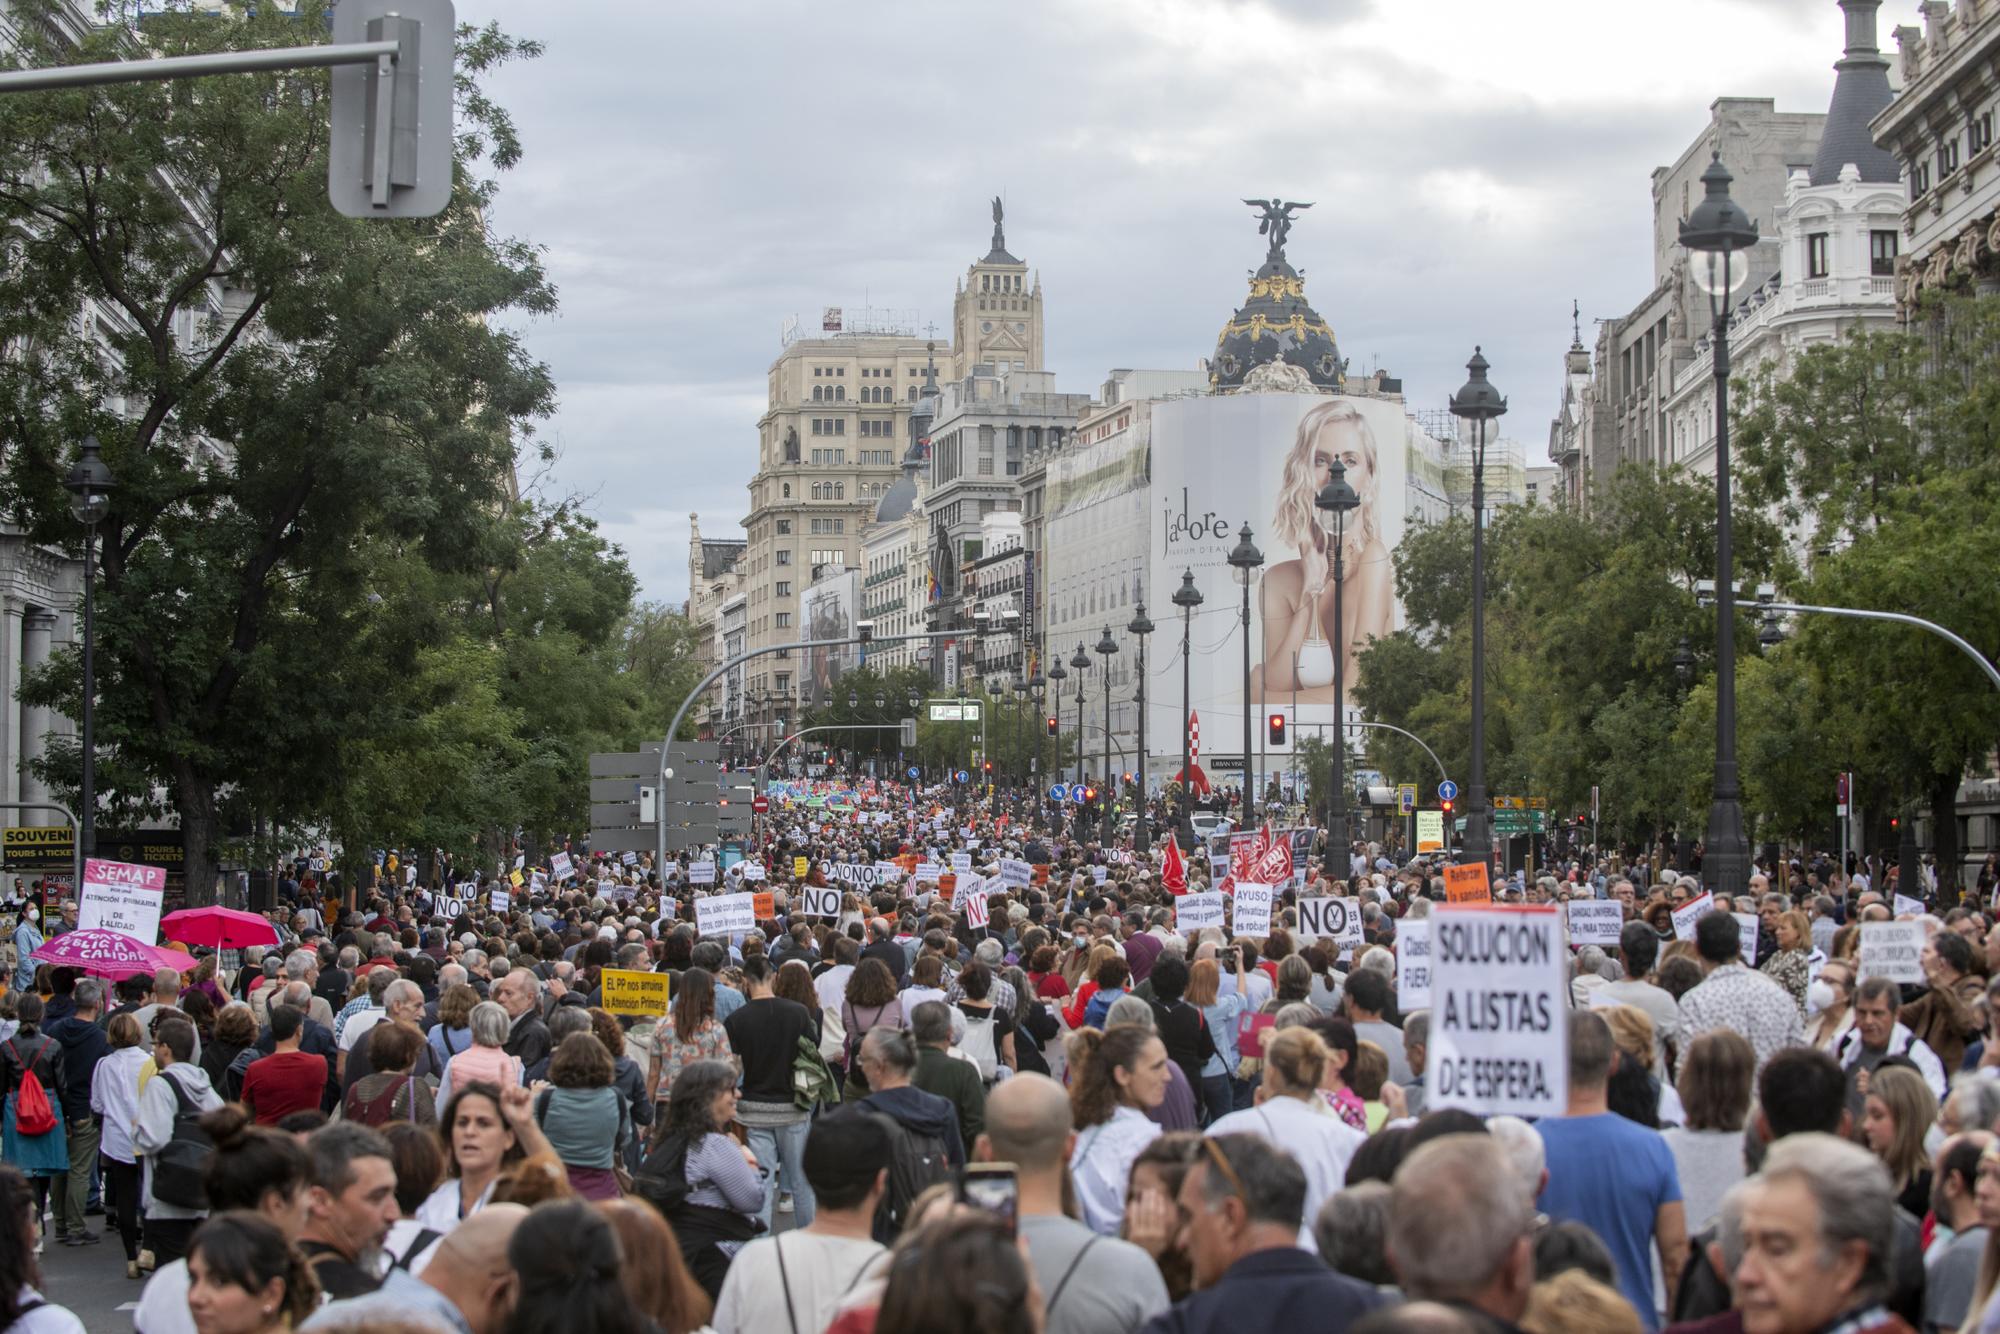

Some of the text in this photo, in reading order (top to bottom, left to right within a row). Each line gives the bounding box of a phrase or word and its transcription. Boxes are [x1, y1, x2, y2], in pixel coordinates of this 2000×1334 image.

[6, 830, 73, 842] SOUVENI
[144, 853, 184, 861] TICKETS
[96, 865, 156, 885] SEMAP
[836, 864, 851, 879] NO
[852, 866, 874, 882] NO
[436, 897, 461, 918] NO
[804, 889, 840, 914] NO
[113, 912, 124, 920] DE
[1299, 900, 1347, 934] NO
[100, 919, 136, 931] CALIDAD
[1236, 922, 1245, 931] es
[1598, 922, 1620, 934] TODOS
[1405, 936, 1431, 956] Clasis
[617, 978, 625, 991] PP
[627, 982, 639, 991] nos
[641, 980, 664, 991] arruina
[611, 996, 639, 1008] Atención
[641, 997, 666, 1010] Primaria
[1444, 991, 1550, 1032] A LISTAS
[1440, 1058, 1468, 1097] DE
